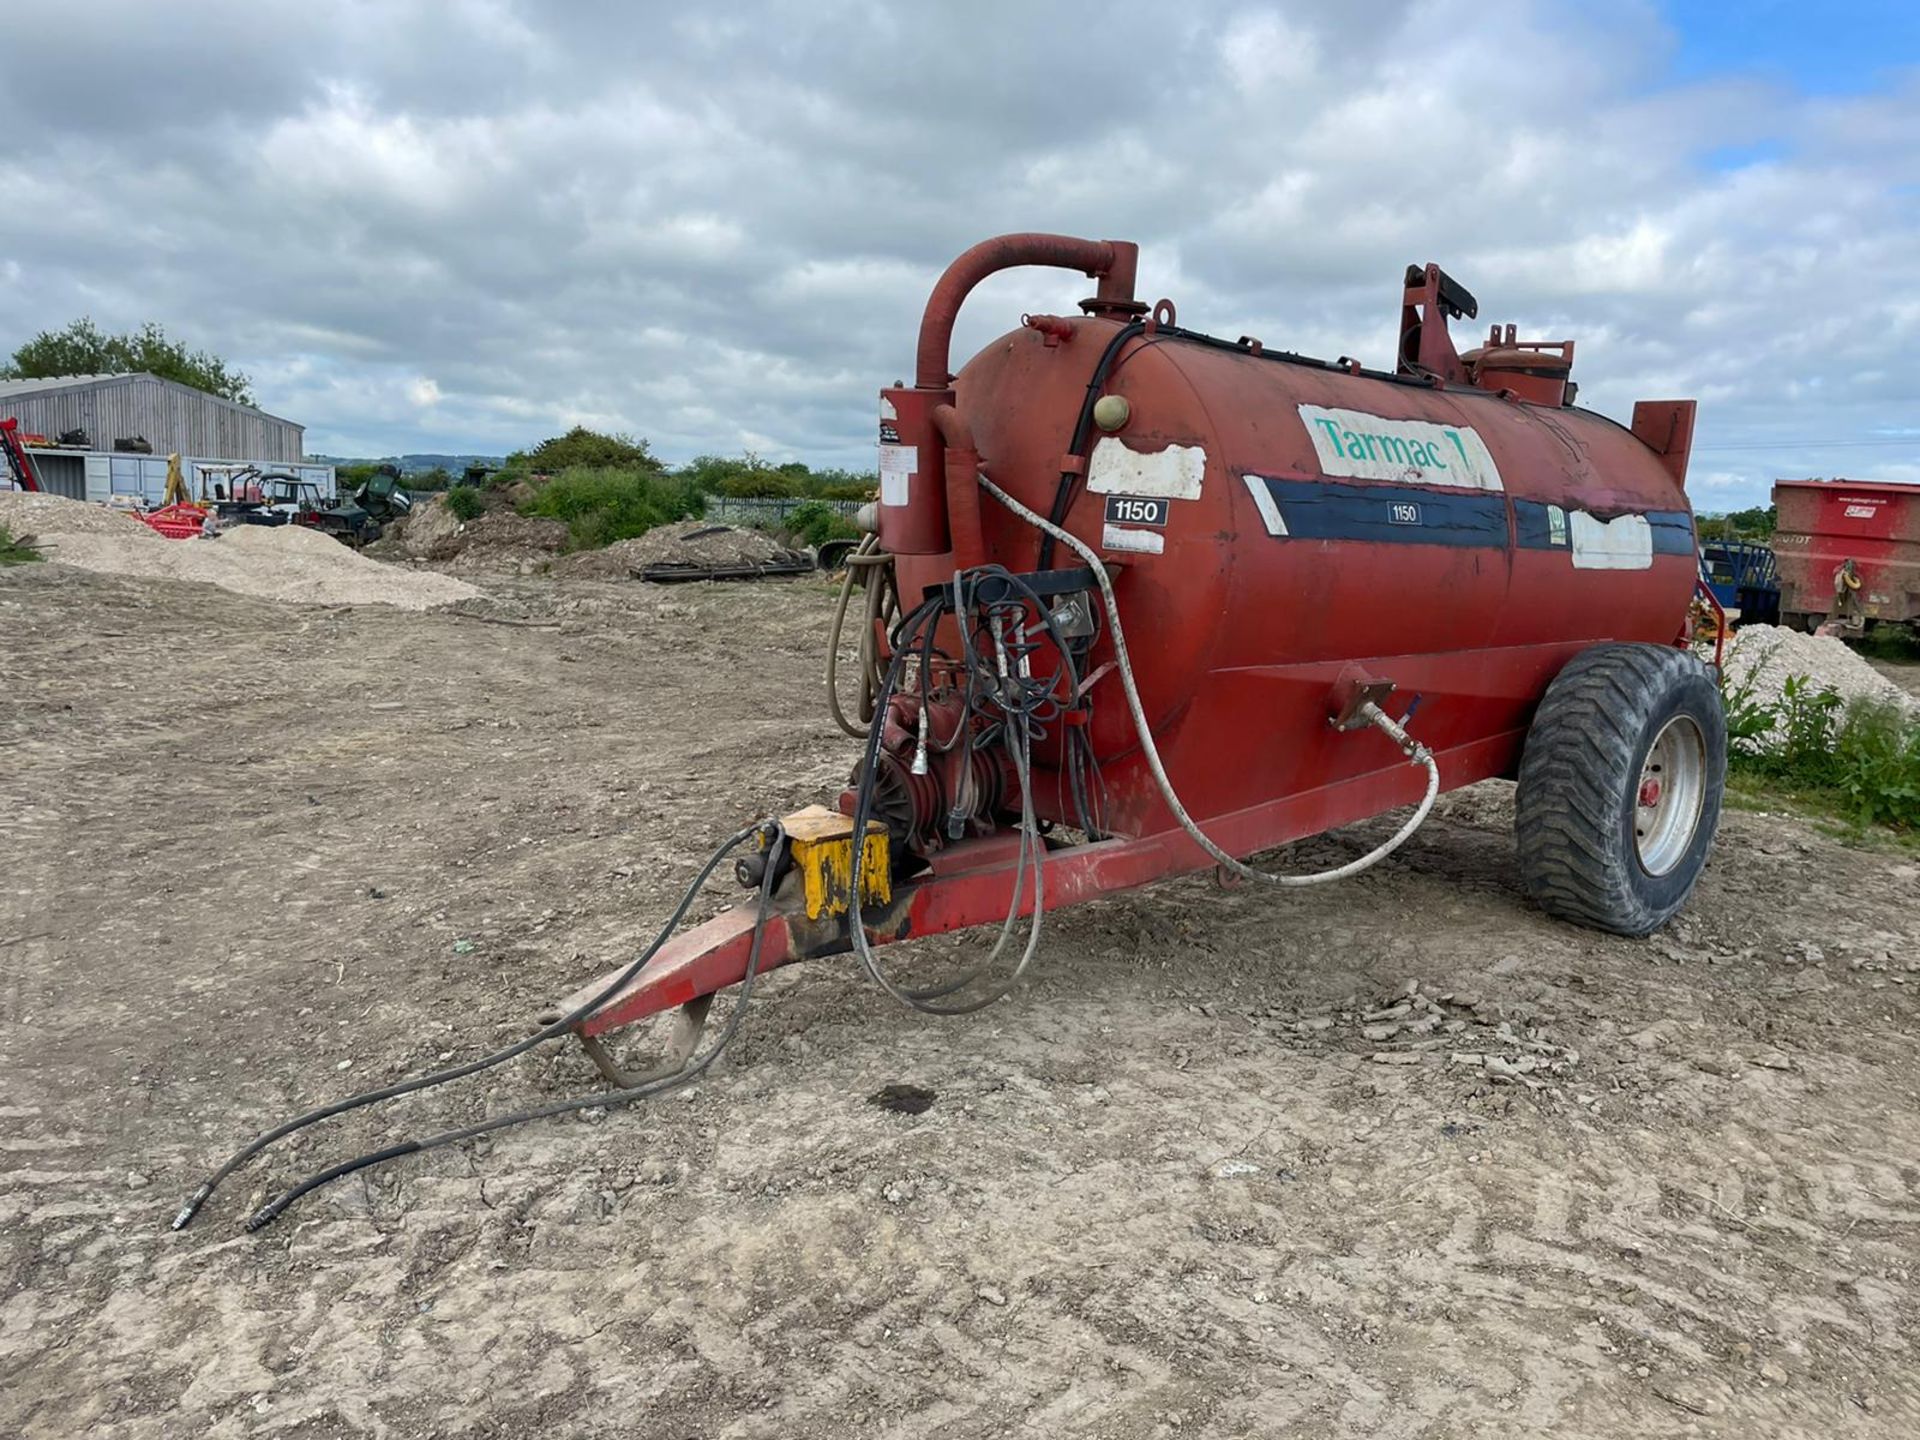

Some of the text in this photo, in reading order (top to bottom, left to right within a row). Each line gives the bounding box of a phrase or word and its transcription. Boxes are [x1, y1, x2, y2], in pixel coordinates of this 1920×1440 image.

[1314, 418, 1447, 469] Tarmac
[1115, 500, 1158, 521] 1150
[1392, 504, 1417, 522] 1150
